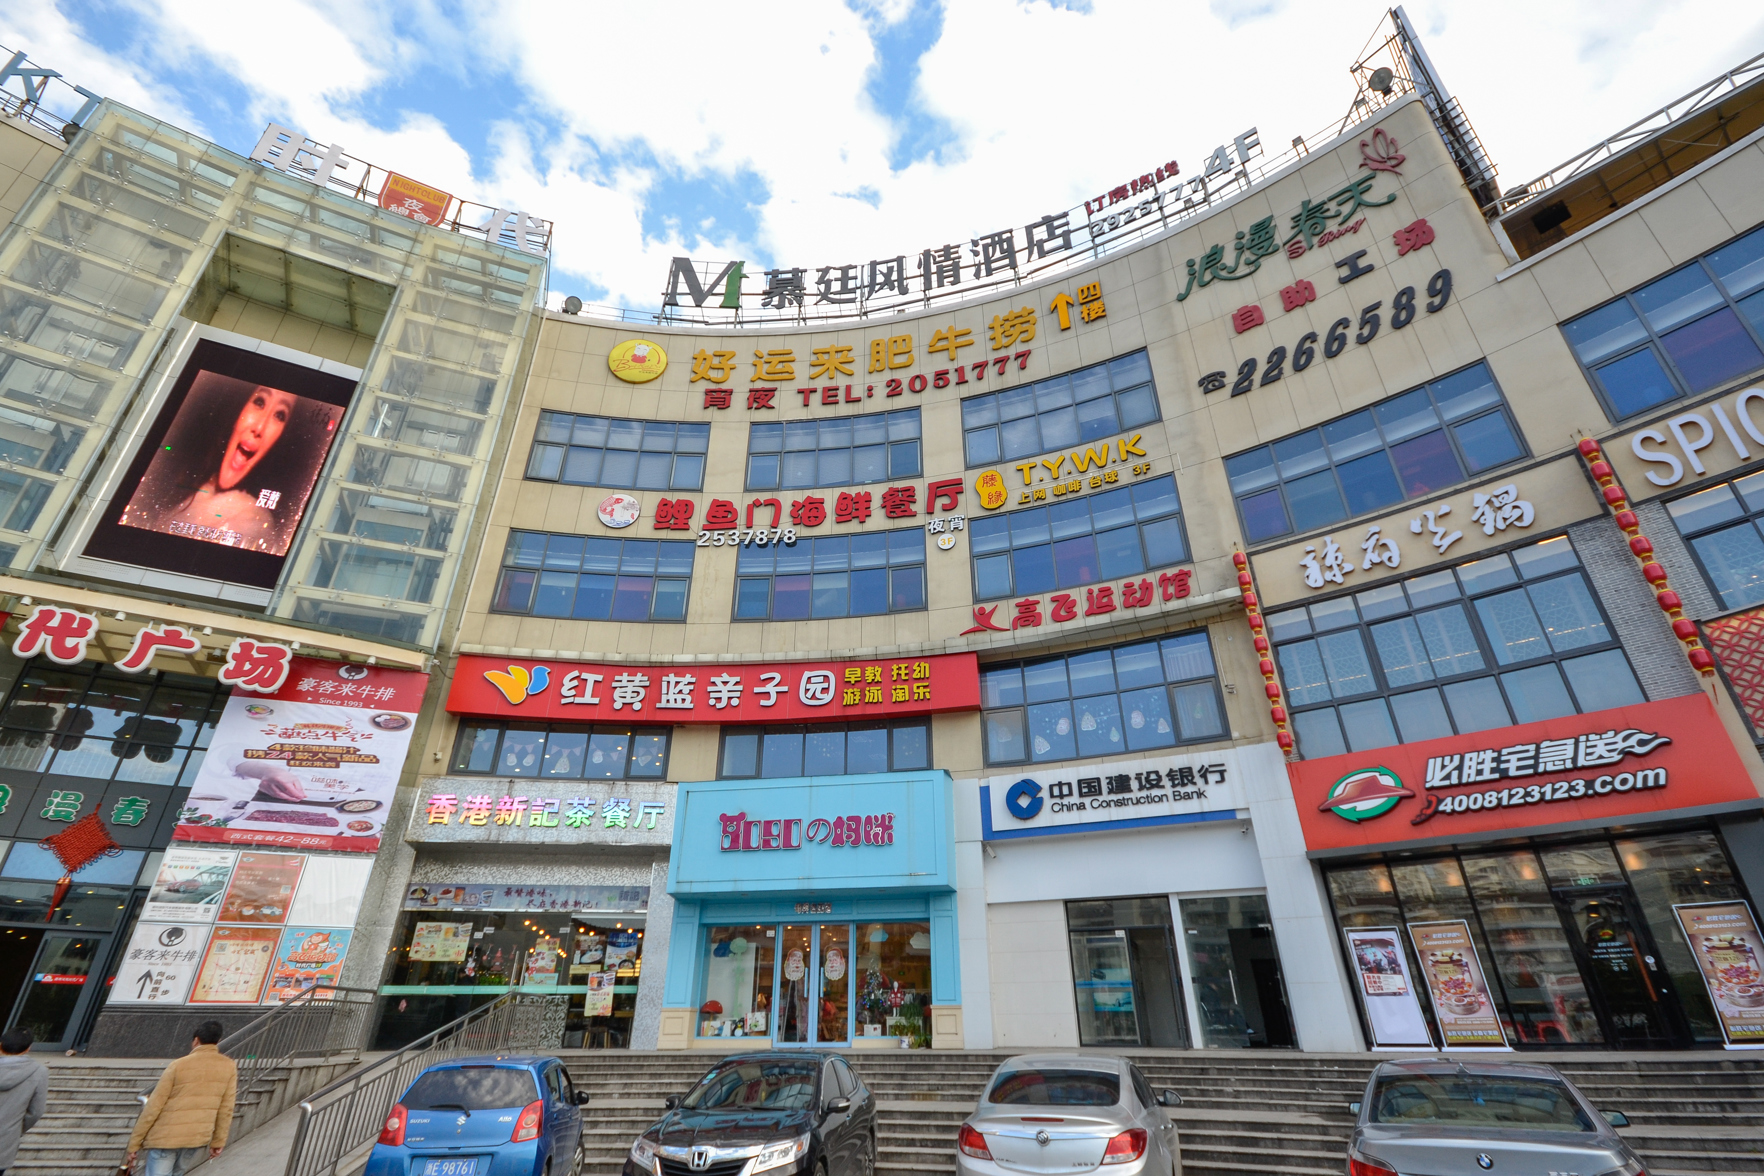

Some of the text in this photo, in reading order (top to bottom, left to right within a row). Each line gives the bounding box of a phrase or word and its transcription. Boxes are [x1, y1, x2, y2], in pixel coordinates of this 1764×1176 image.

[1204, 126, 1261, 178] 4F
[392, 178, 446, 204] NIGHTCLUB
[1091, 174, 1203, 239] 2925777
[1176, 172, 1397, 301] 浪漫春天
[761, 211, 1073, 309] 慕廷风情酒店
[1231, 218, 1436, 334] 自助工场
[1077, 281, 1107, 324] 四楼
[690, 306, 1037, 383] 好运来肥牛捞
[1230, 268, 1453, 398] 2266589
[703, 386, 778, 410] 宵夜
[1016, 433, 1147, 486] T.Y.W.K
[654, 478, 964, 530] 鲤鱼门海鲜餐厅
[1017, 462, 1152, 505] 上网 咖啡 台球 3F
[697, 528, 796, 547] 2537878
[928, 514, 966, 534] 夜宵
[940, 537, 954, 546] 3F
[1011, 569, 1192, 630] 高飞运动馆
[12, 604, 293, 693] 代广场
[296, 677, 397, 701] 豪客来牛排
[560, 669, 836, 711] 红黄蓝亲子园
[843, 682, 931, 706] 游泳 淘乐
[844, 662, 931, 685] 早教 托幼
[319, 697, 363, 708] Since 1993
[1425, 729, 1624, 789] 必胜宅急送
[1048, 763, 1227, 800] 中国建设银行
[1051, 787, 1208, 814] China Construction Bank
[1438, 767, 1667, 814] 4008123123.com
[425, 794, 666, 830] 香港新記茶餐厅
[129, 948, 198, 962] 豪客来牛排
